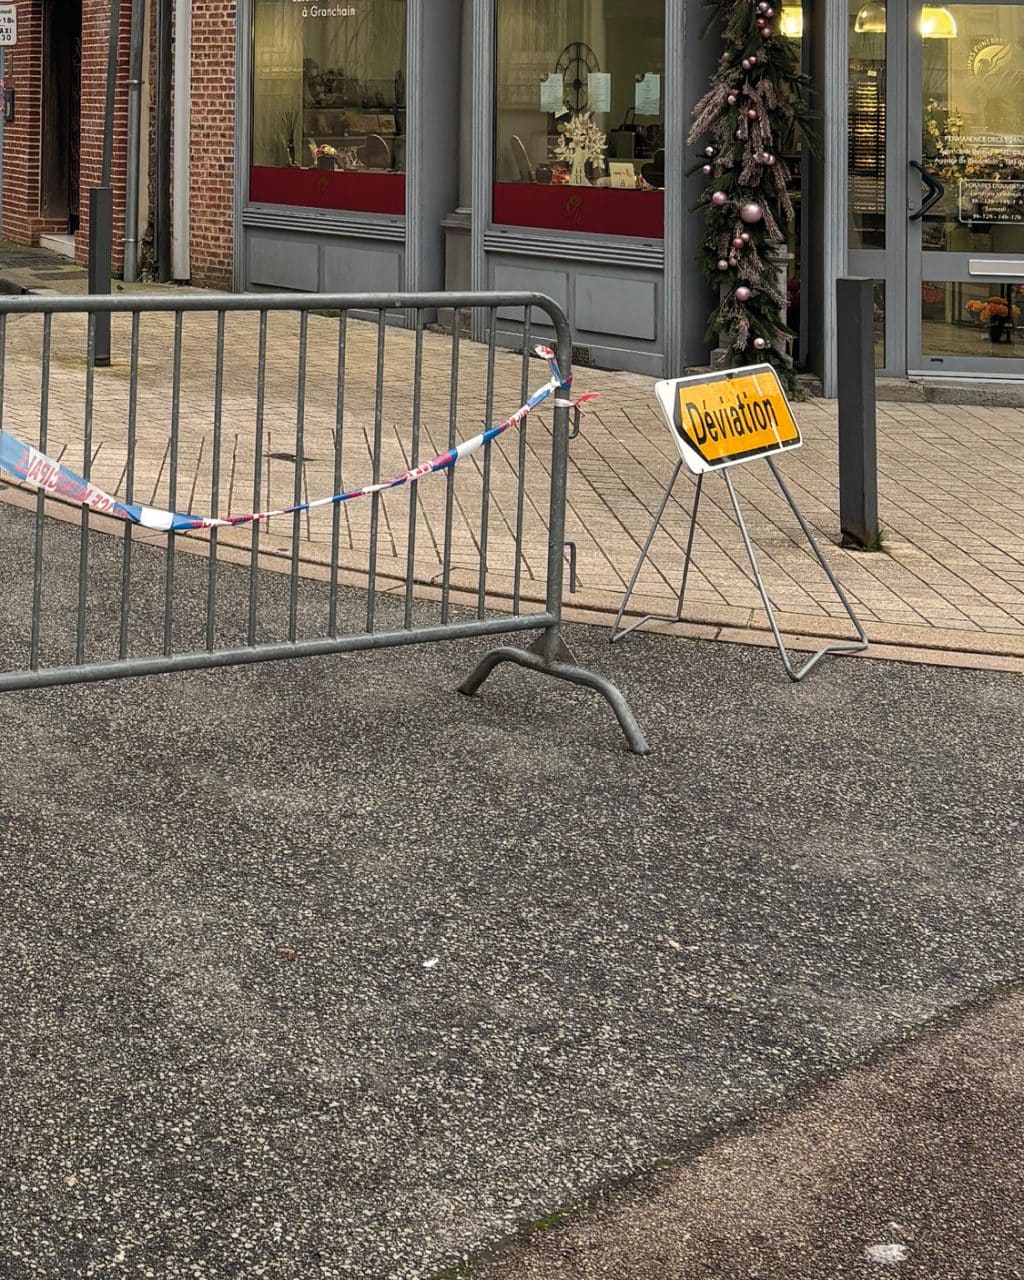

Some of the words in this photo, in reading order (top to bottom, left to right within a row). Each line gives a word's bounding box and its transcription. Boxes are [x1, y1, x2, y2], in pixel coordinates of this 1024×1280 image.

[302, 6, 308, 17] à
[310, 5, 356, 17] Granchain
[685, 391, 779, 446] Déviation
